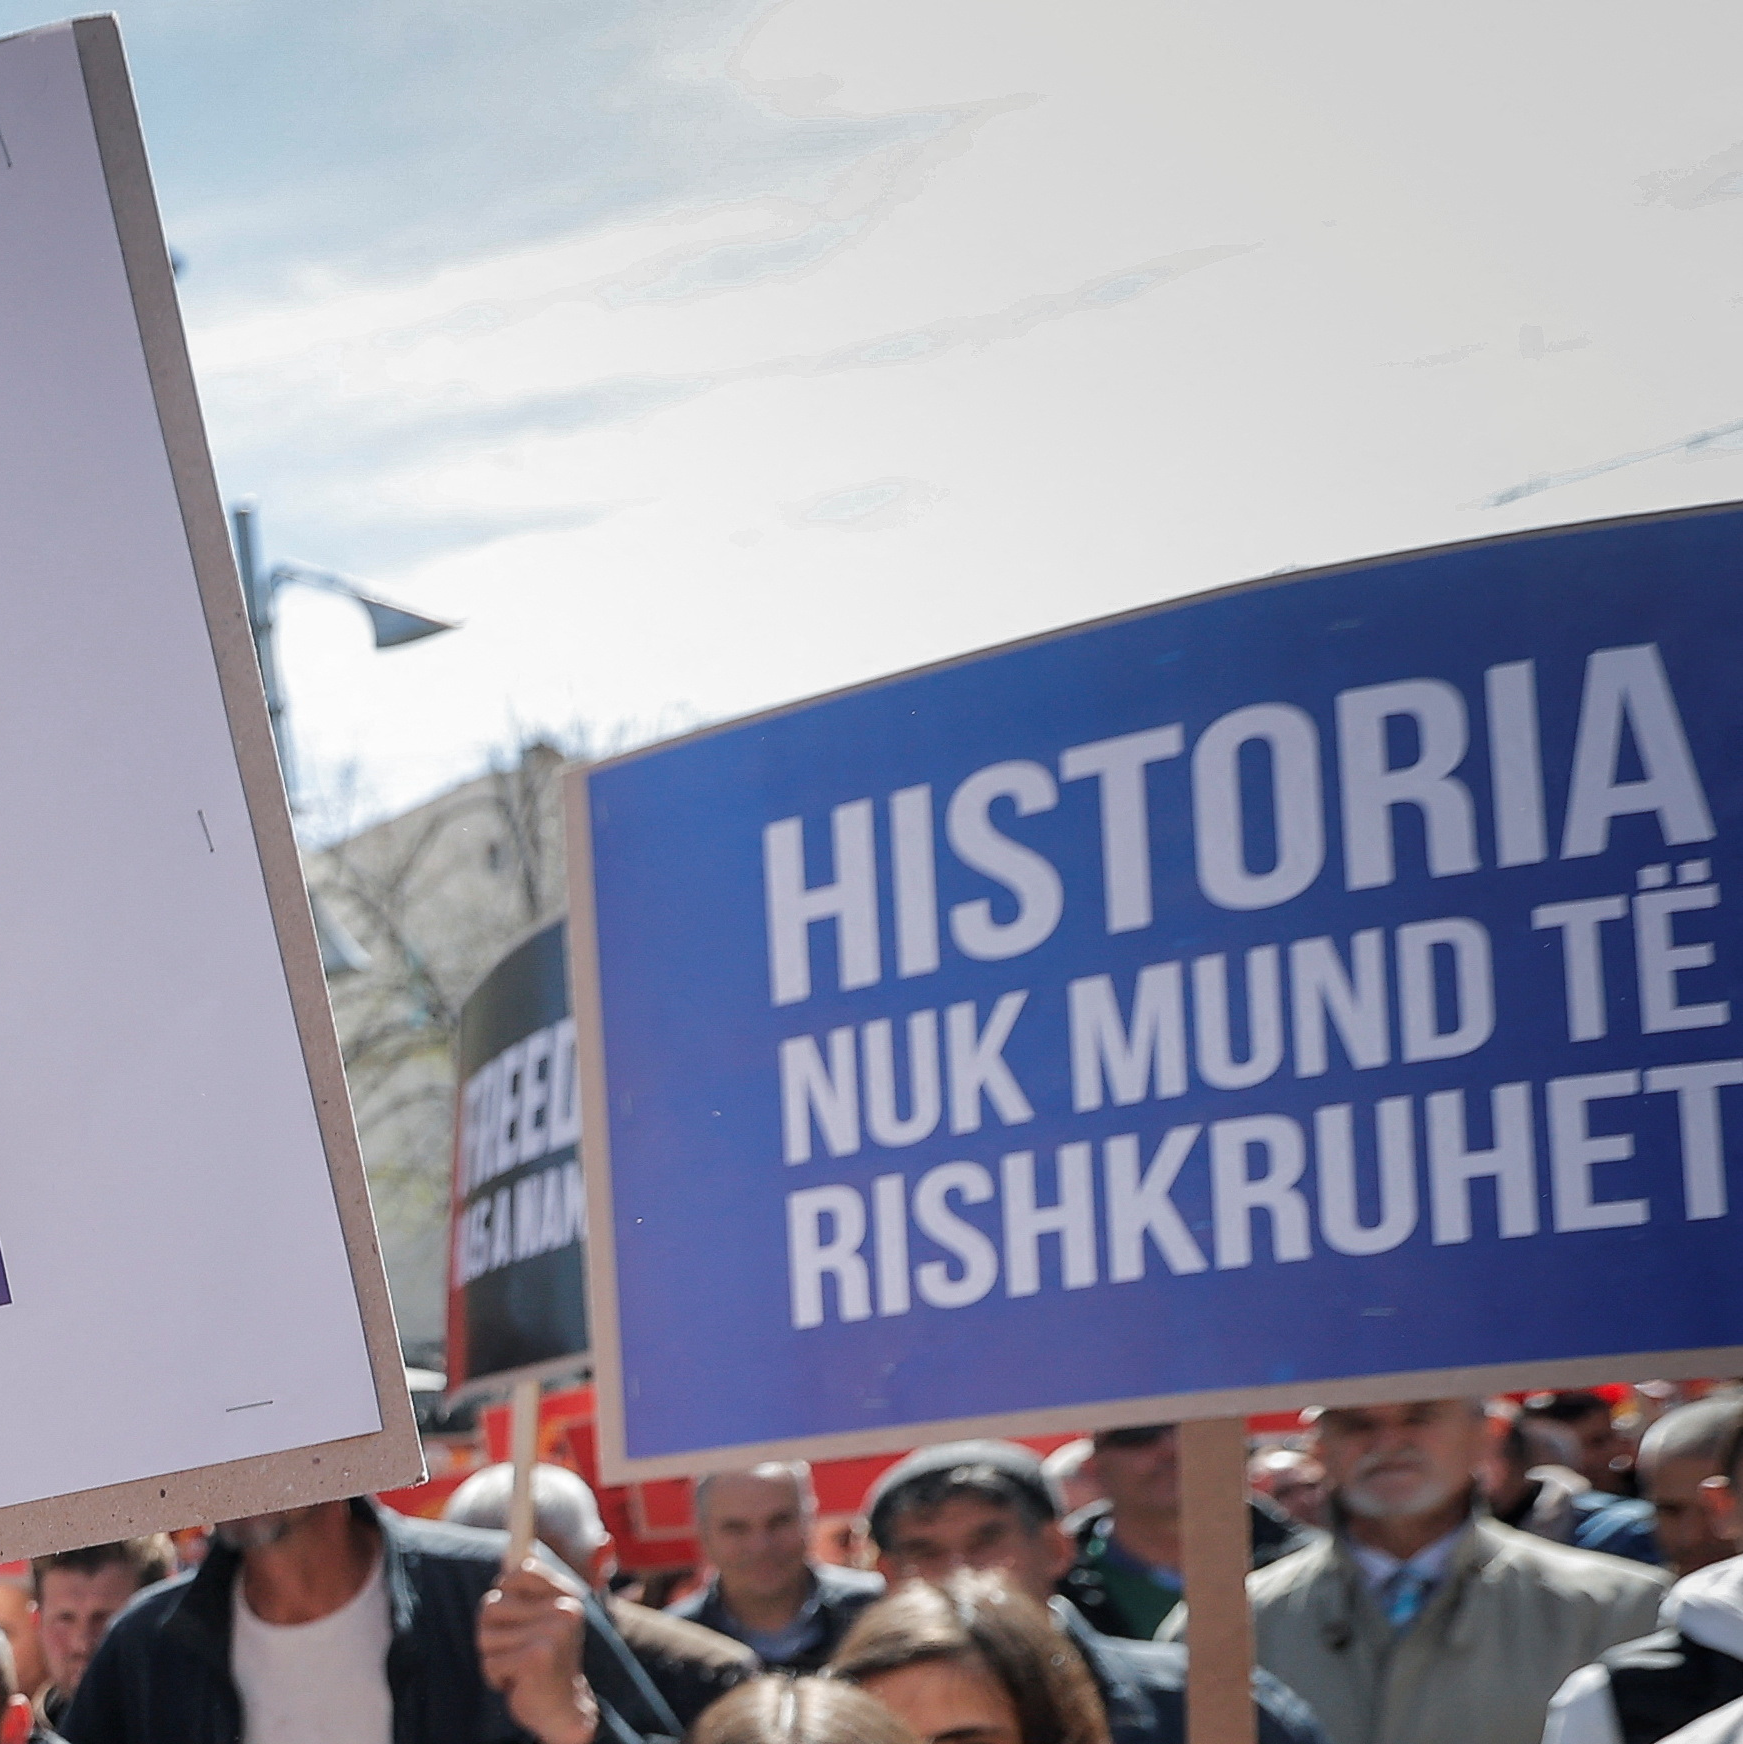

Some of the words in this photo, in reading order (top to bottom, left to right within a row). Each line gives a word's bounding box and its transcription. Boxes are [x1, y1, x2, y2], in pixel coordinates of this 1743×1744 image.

[762, 642, 1717, 1007] HISTORIA
[459, 1016, 583, 1200] FREED
[777, 990, 1035, 1167] NUK
[1067, 916, 1497, 1114] MUND
[1531, 858, 1731, 1043] TË
[513, 1161, 588, 1263] NAM
[786, 1058, 1743, 1331] RISHKRUHET
